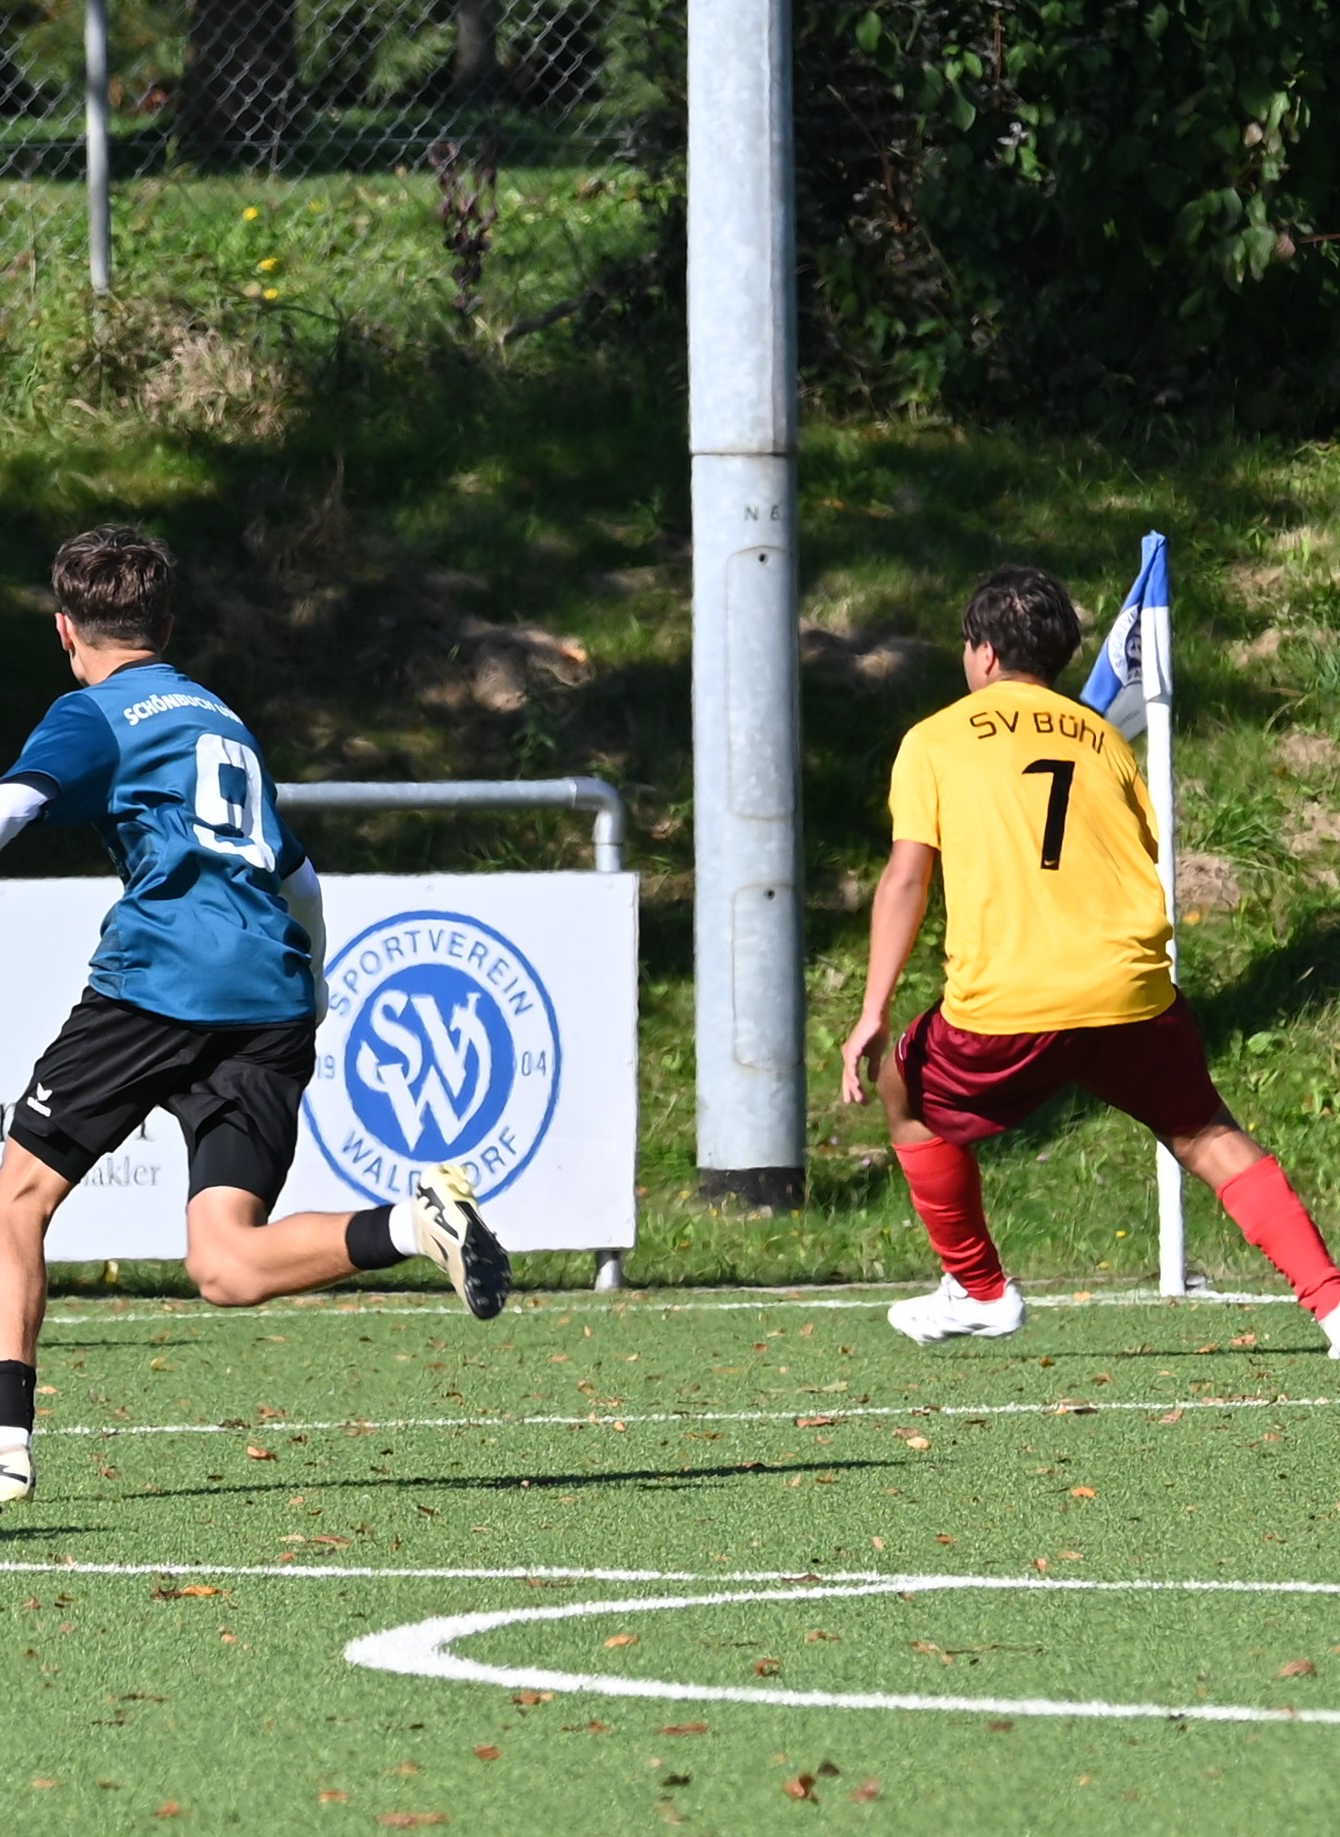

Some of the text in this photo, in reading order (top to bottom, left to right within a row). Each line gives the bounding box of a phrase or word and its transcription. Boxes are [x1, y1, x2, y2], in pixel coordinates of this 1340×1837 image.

[123, 693, 218, 727] SCHÖNBUCH
[969, 710, 1105, 755] SV Bühl
[192, 732, 276, 874] 9
[1021, 758, 1076, 871] 7
[328, 928, 534, 1018] SPORTVEREIN
[521, 1050, 547, 1078] 04
